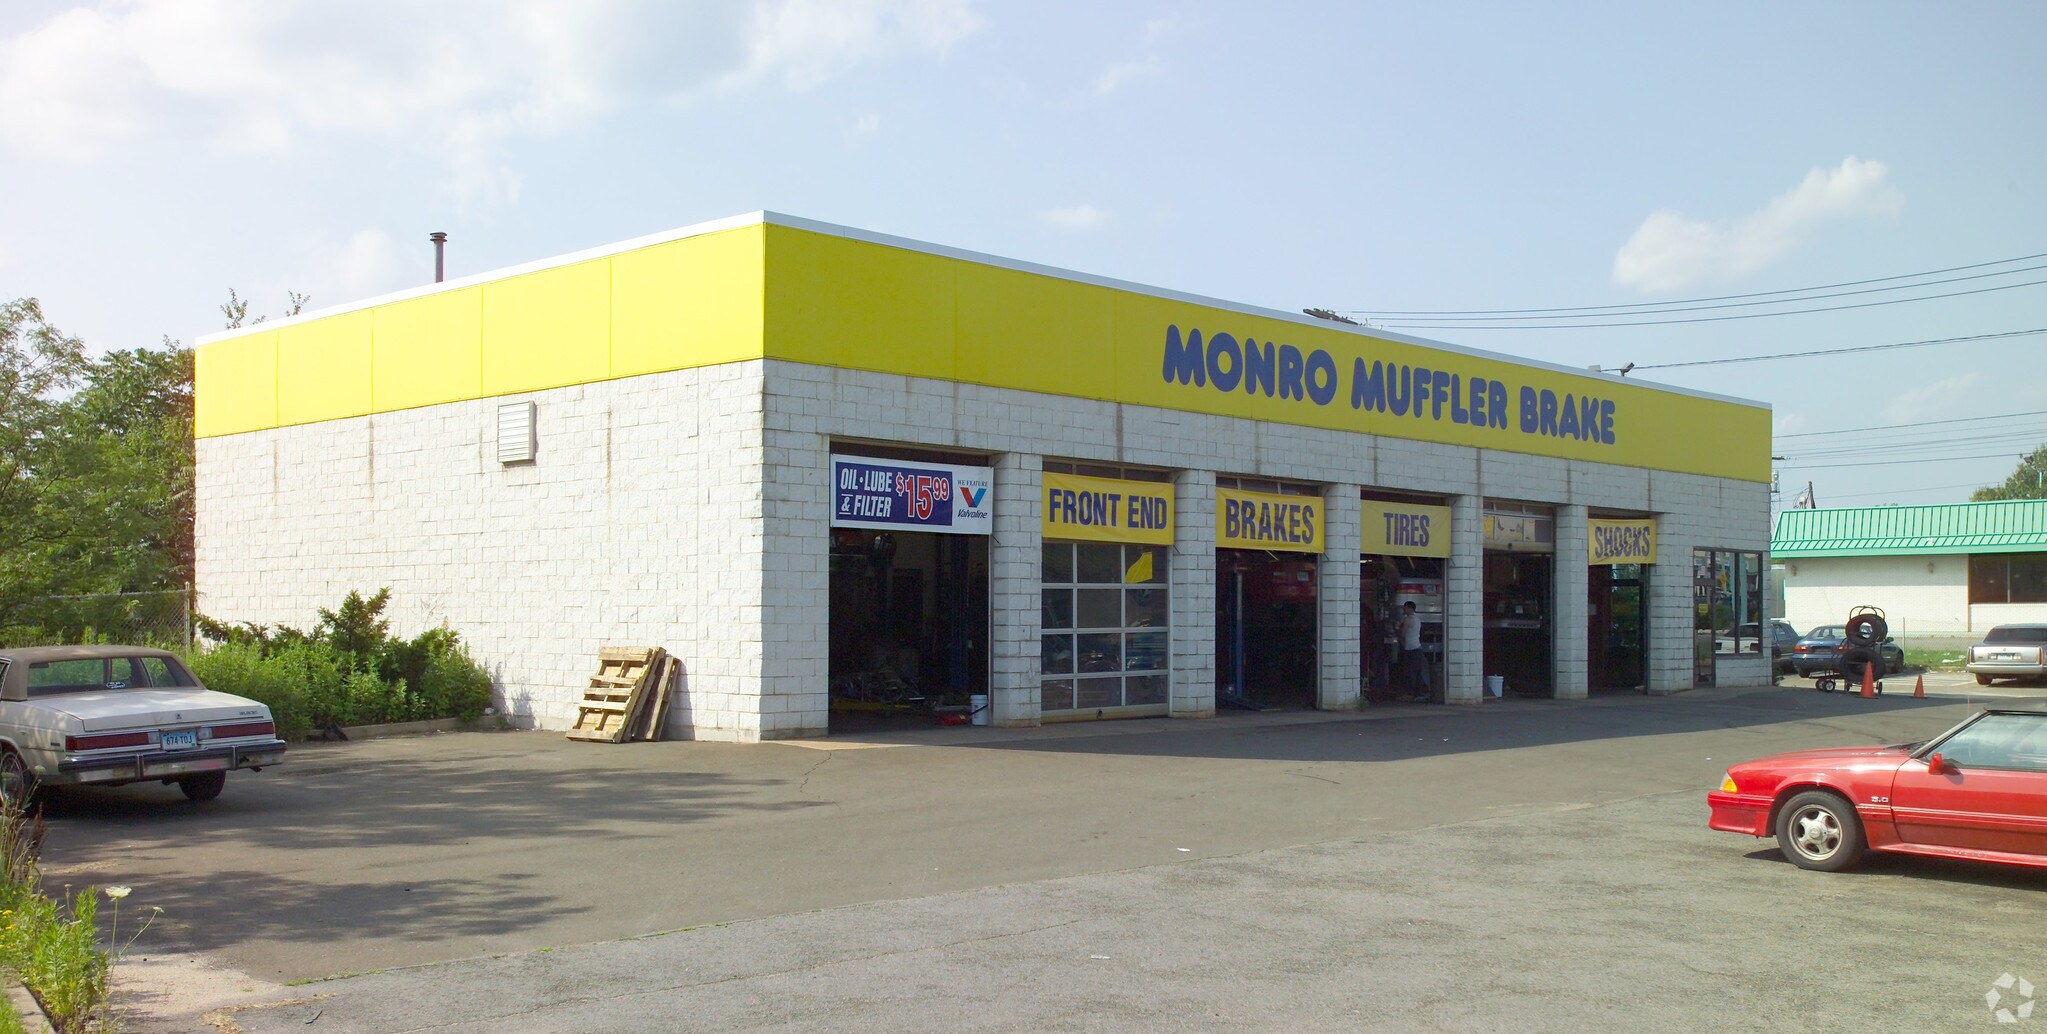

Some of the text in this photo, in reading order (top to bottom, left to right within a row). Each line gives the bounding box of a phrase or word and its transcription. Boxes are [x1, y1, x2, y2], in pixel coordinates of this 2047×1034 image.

[1162, 324, 1616, 445] MONRO MUFFLER BRAKE
[853, 494, 892, 517] FILTER
[957, 508, 988, 519] Valvoline
[1049, 488, 1167, 530] FRONT END
[1225, 498, 1315, 545] BRAKES
[1383, 512, 1430, 547] TIRES
[1594, 526, 1651, 558] SHOCKS
